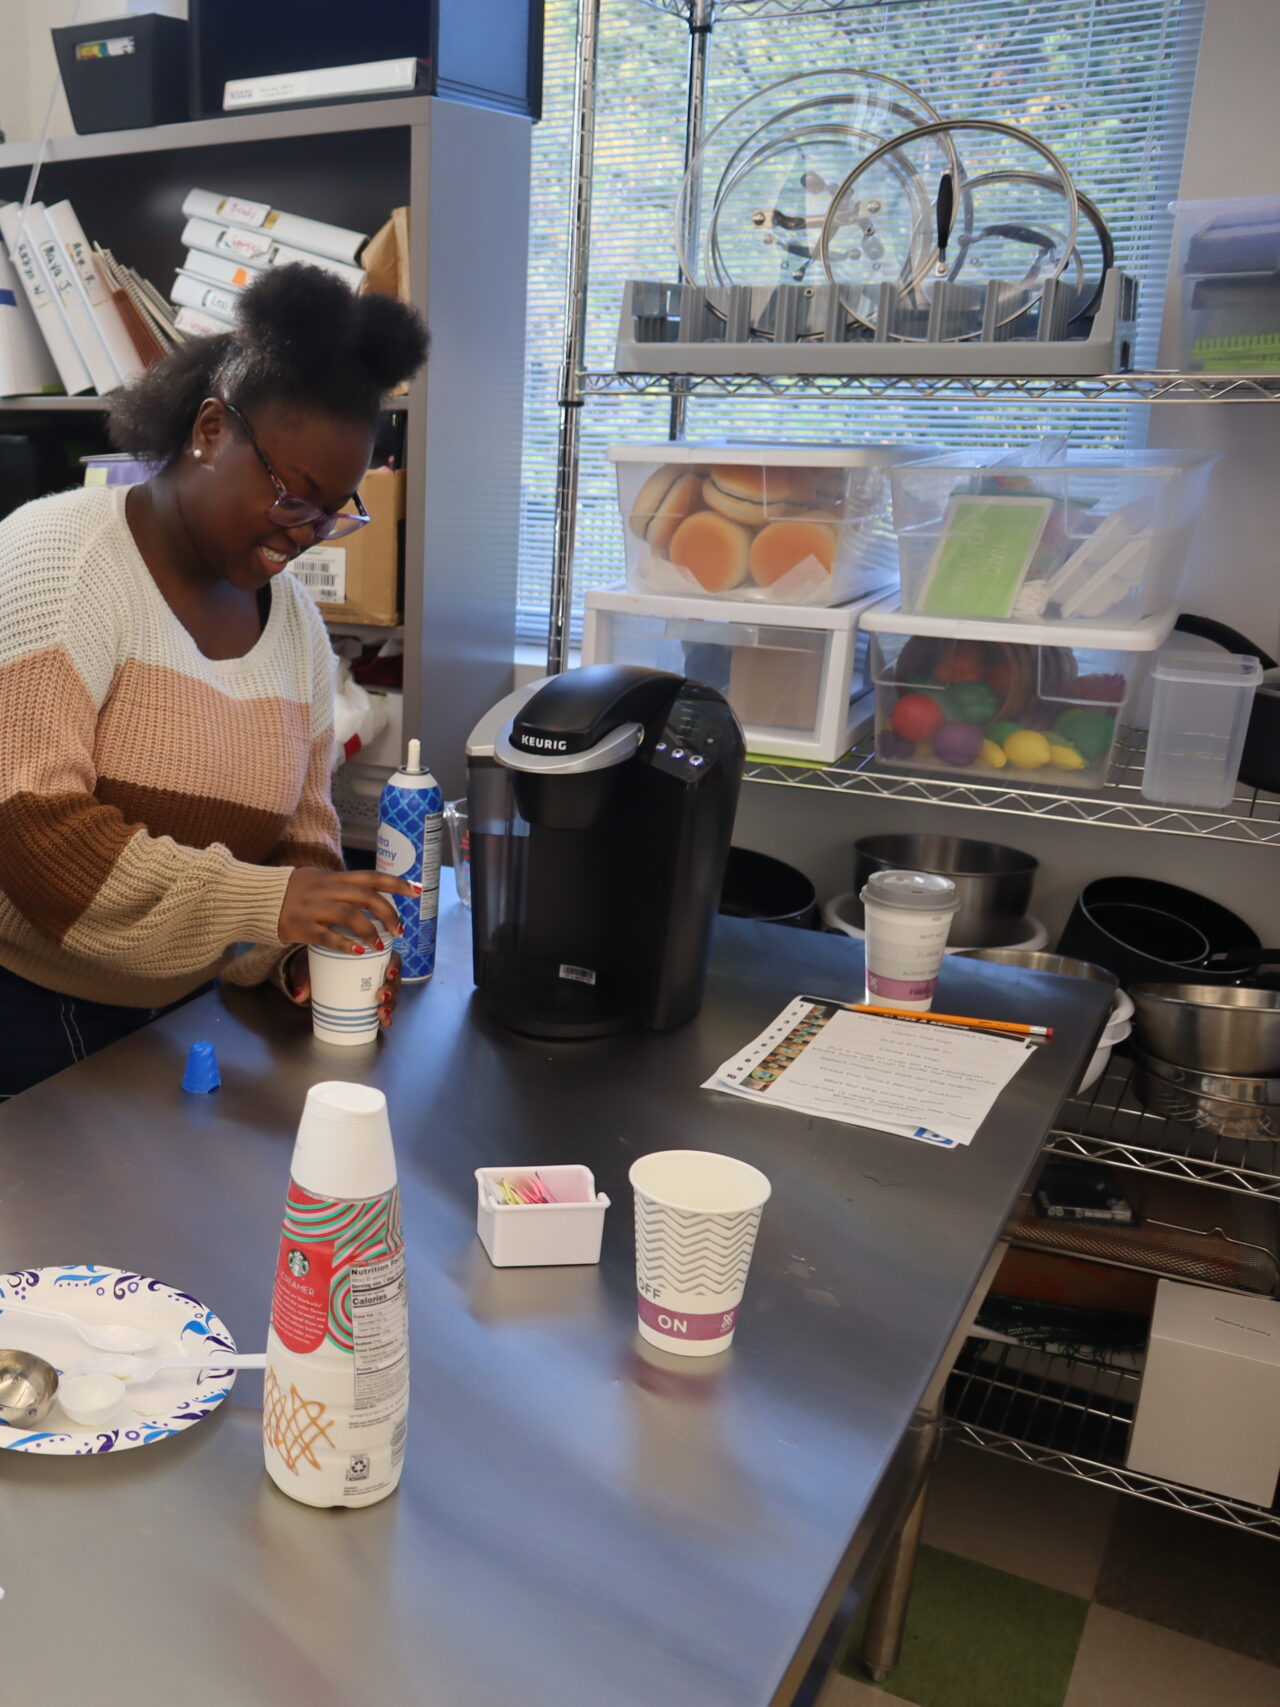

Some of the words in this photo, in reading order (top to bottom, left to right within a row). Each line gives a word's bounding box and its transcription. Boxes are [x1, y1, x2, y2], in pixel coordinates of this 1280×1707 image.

[521, 734, 567, 750] KEURIG
[351, 1264, 389, 1276] Nutrition
[279, 1271, 315, 1296] CREAMER
[638, 1277, 661, 1299] OFF
[352, 1294, 387, 1305] Calories
[657, 1314, 688, 1334] ON
